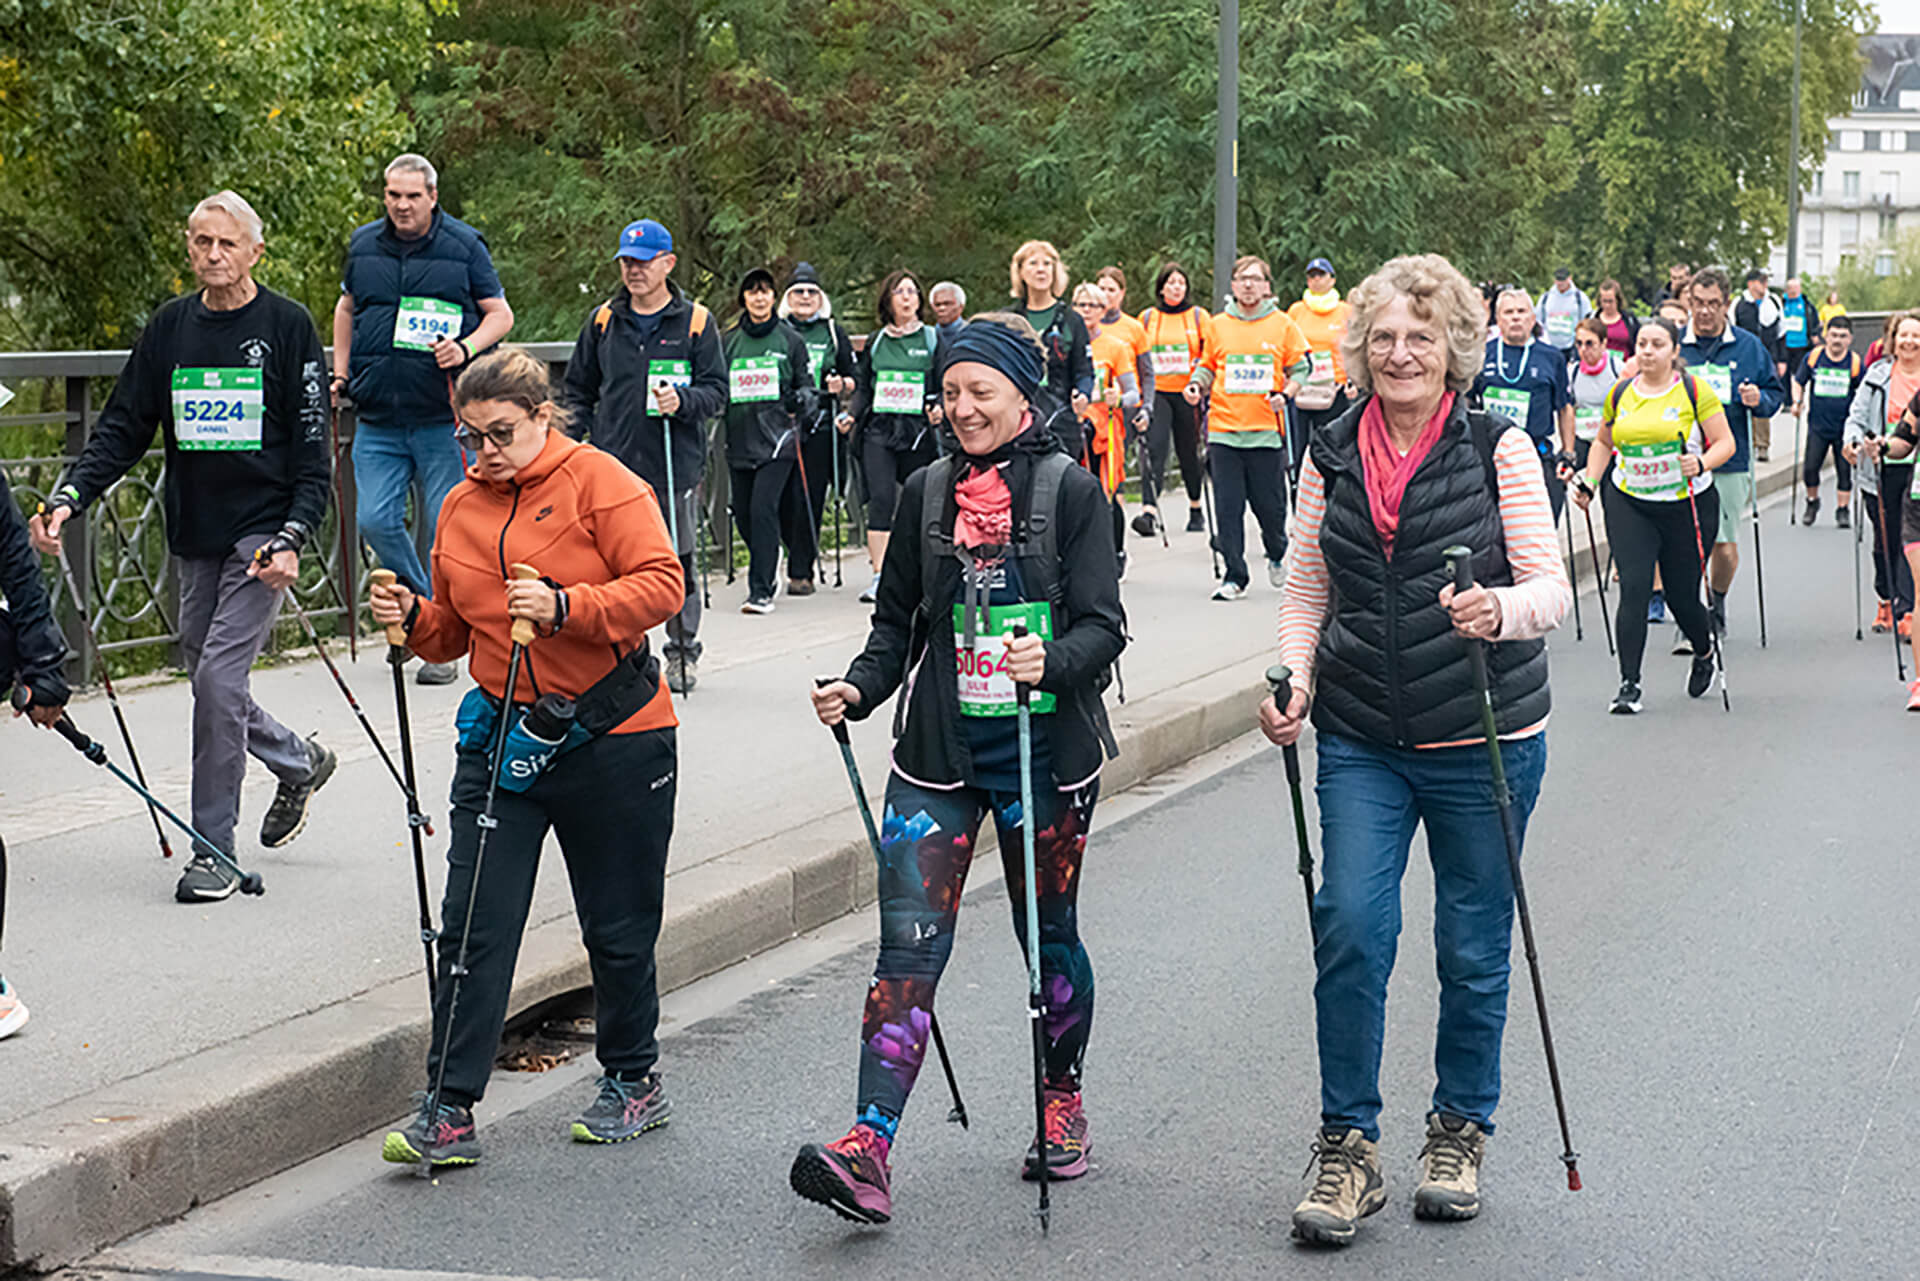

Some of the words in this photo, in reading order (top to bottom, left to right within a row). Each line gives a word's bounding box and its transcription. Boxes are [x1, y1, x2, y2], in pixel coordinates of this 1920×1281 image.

[408, 316, 449, 334] 5194
[738, 374, 770, 387] 5070
[1234, 369, 1265, 380] 5287
[184, 400, 245, 421] 5224
[196, 426, 229, 434] DANIEL
[1633, 460, 1670, 476] 5273
